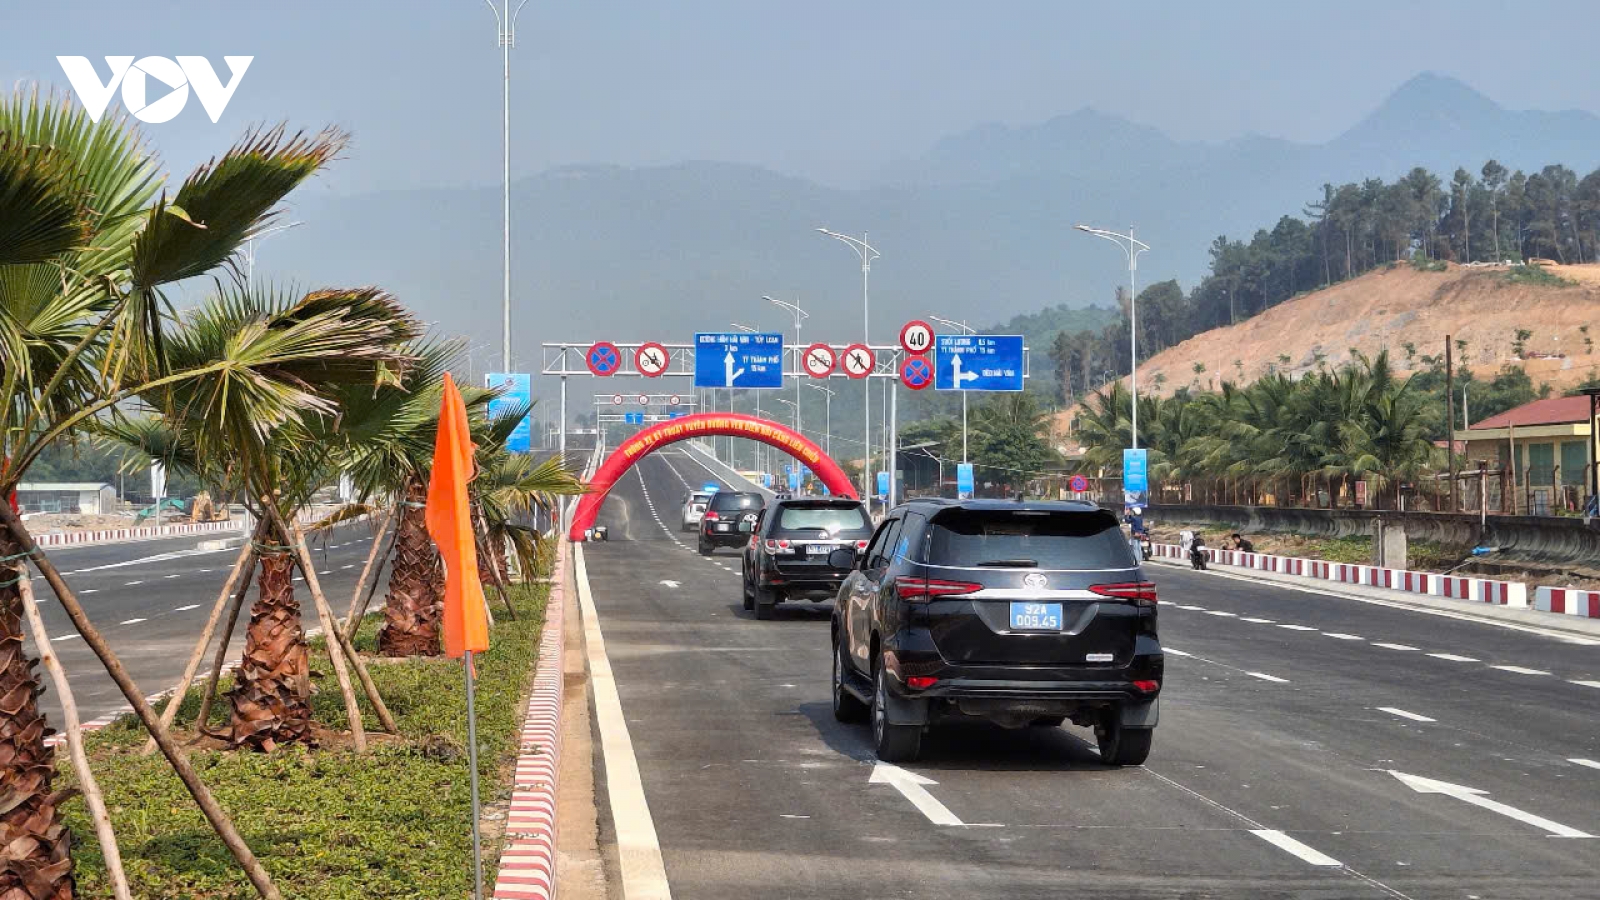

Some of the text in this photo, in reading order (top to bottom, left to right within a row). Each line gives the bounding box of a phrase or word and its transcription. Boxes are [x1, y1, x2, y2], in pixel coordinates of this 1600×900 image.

[910, 332, 924, 346] 40
[730, 344, 738, 352] km
[1024, 604, 1047, 615] 92A
[1016, 615, 1057, 627] 009.45
